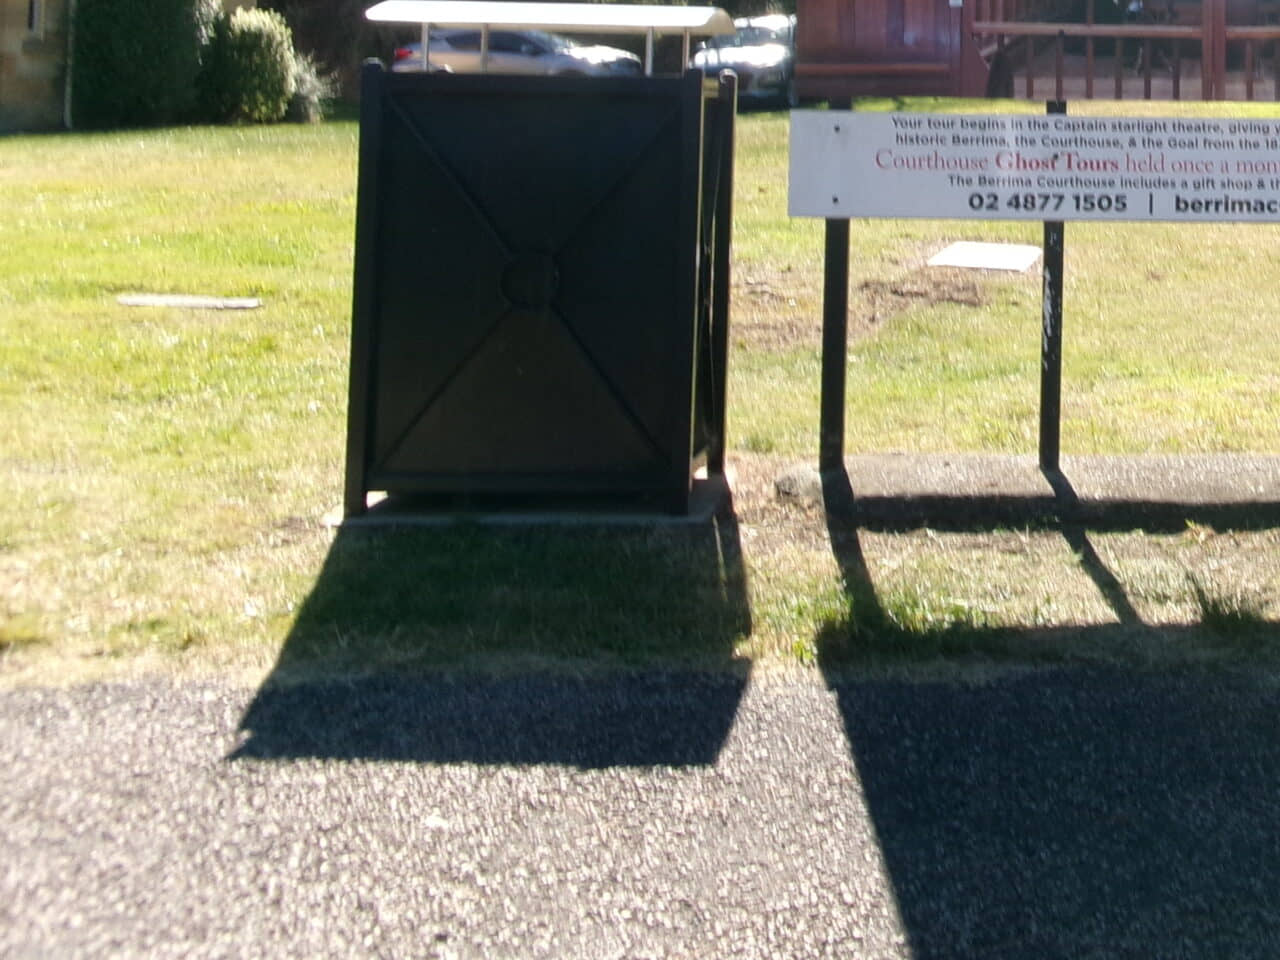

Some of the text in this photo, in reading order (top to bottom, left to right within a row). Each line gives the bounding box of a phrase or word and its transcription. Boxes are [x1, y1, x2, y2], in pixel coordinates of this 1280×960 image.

[892, 117, 923, 130] Your
[927, 118, 956, 131] tour
[960, 118, 1006, 133] begins
[1011, 118, 1023, 130] in
[1028, 119, 1049, 131] the
[1054, 119, 1106, 134] Captain
[1110, 119, 1167, 135] starlight
[1172, 120, 1224, 135] theatre,
[1229, 121, 1271, 136] giving
[896, 133, 947, 146] historic
[1015, 134, 1037, 147] the
[1141, 136, 1163, 149] the
[1167, 137, 1199, 149] Goal
[1203, 137, 1234, 150] from
[1238, 138, 1260, 151] the
[875, 147, 989, 171] Courthouse
[995, 150, 1058, 172] Ghost
[1060, 151, 1119, 173] Tours
[1125, 153, 1165, 173] held
[1171, 159, 1215, 173] once
[1219, 160, 1230, 174] a
[948, 174, 973, 186] The
[978, 174, 1032, 188] Berrima
[1037, 176, 1116, 189] Courthouse
[1120, 176, 1176, 189] includes
[1180, 180, 1188, 189] a
[1192, 177, 1216, 191] gift
[1220, 178, 1253, 192] shop
[968, 193, 1000, 211] 02
[1006, 193, 1065, 212] 4877
[1073, 193, 1128, 212] 1505
